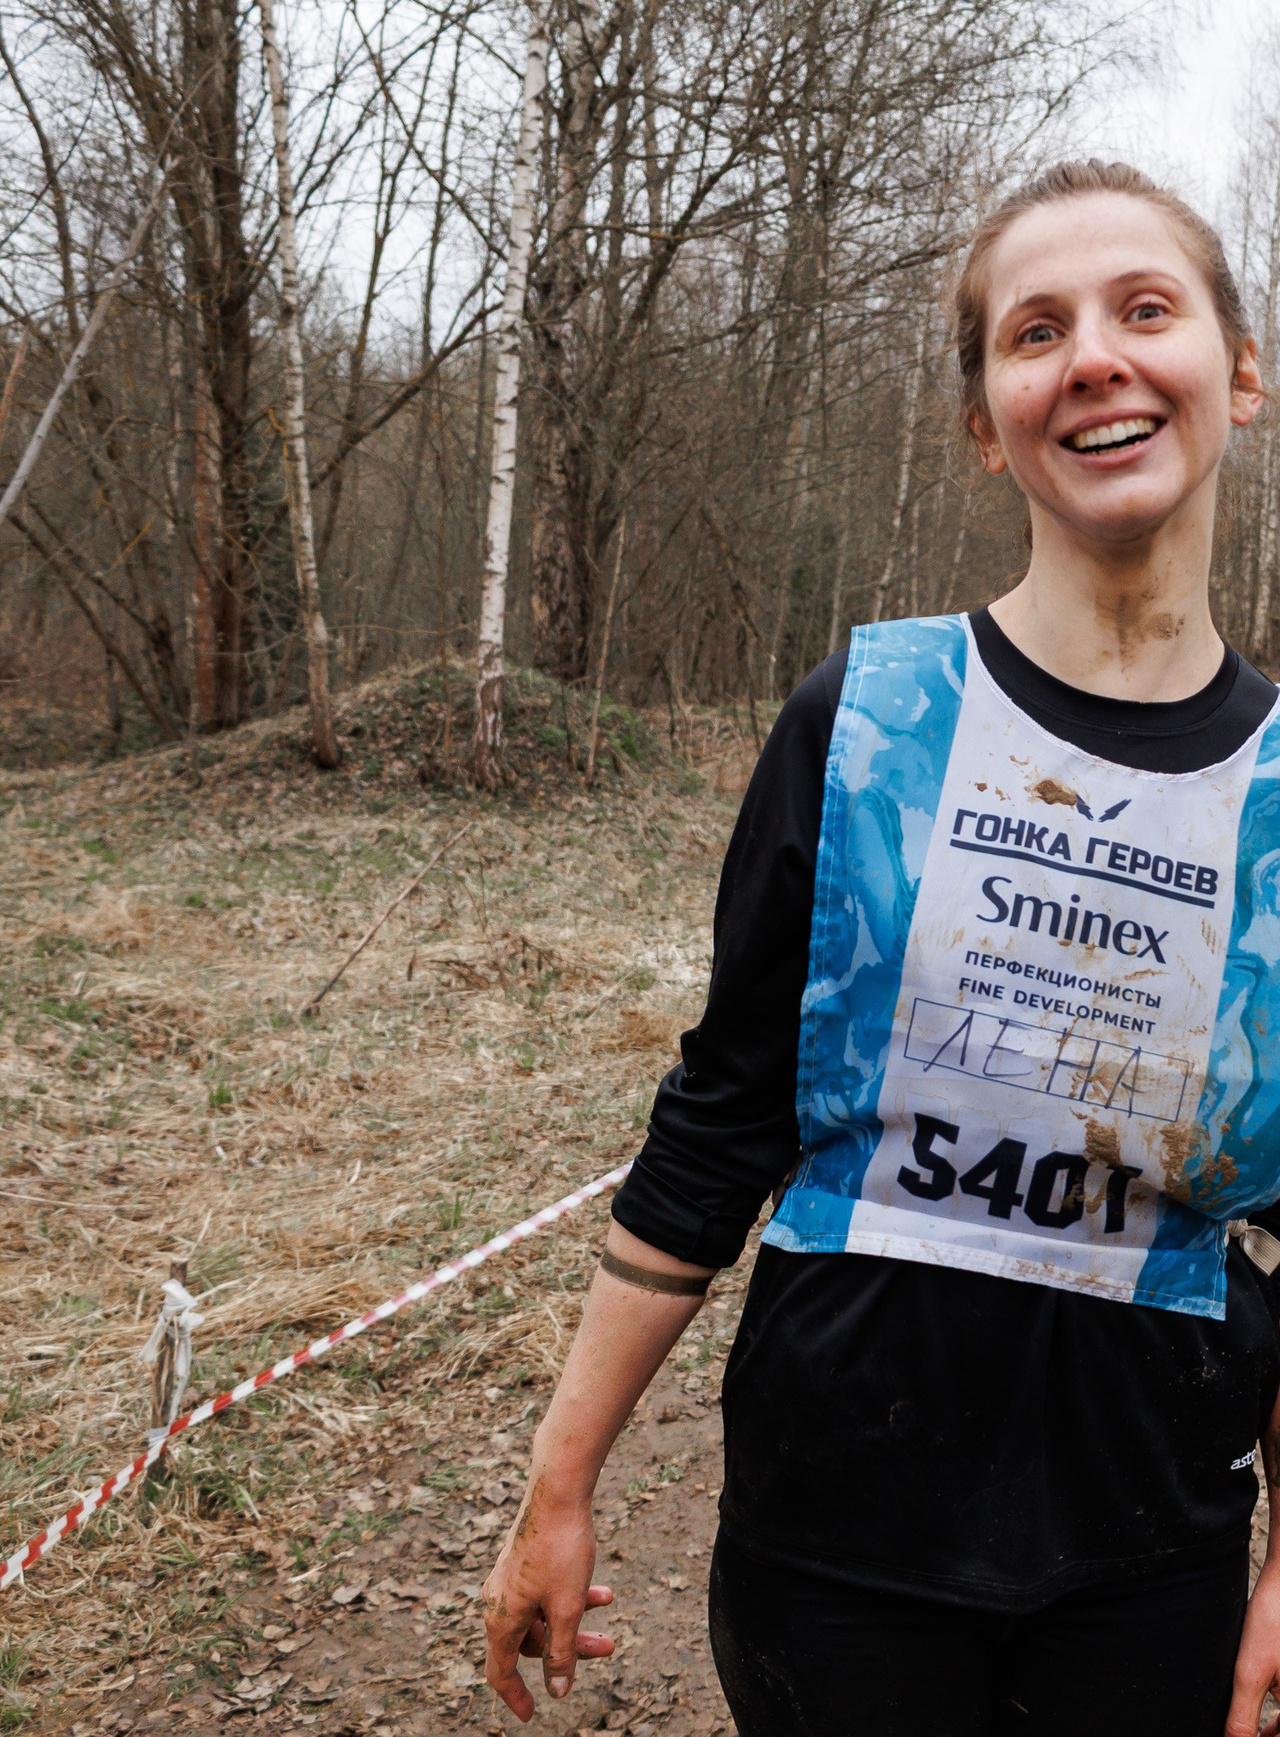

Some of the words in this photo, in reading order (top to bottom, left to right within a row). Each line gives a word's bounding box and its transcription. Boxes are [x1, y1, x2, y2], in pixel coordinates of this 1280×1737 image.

[952, 808, 1072, 861] ГОНКА
[1085, 837, 1218, 896] ГЕРОЕВ
[976, 876, 1169, 964] Sminex
[958, 977, 1005, 999] FINE
[1013, 989, 1156, 1035] DEVELOPMENT
[964, 950, 1162, 1009] ПЕРФЕКЦИОНИСТЫ
[923, 1009, 1152, 1118] ЛЕНА
